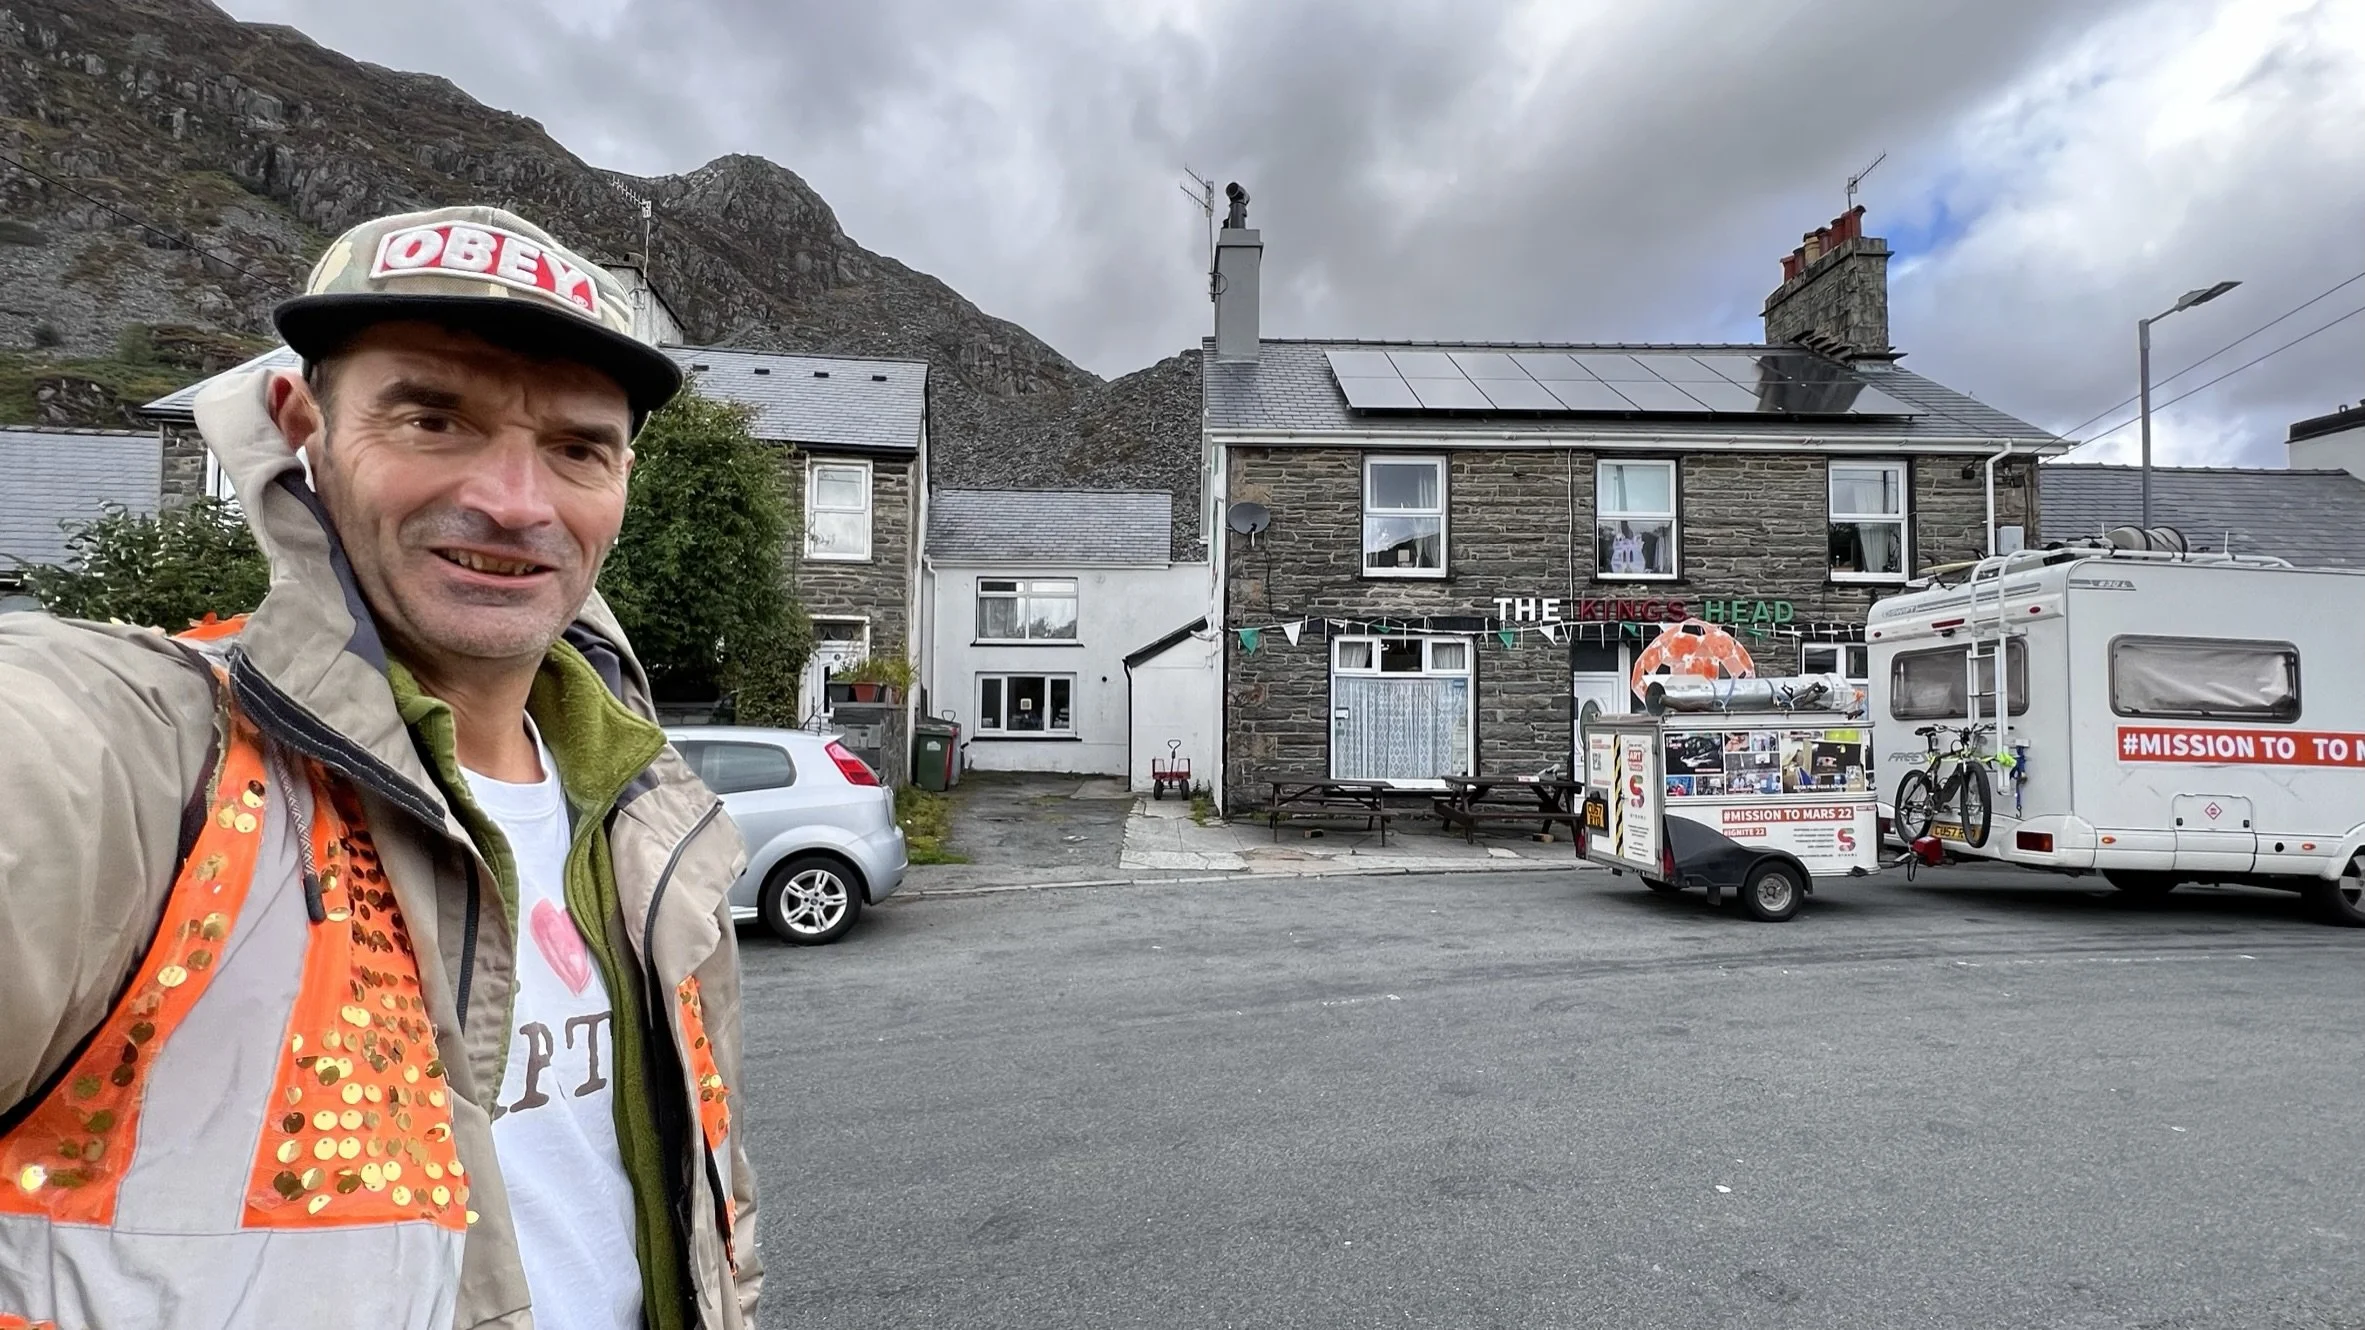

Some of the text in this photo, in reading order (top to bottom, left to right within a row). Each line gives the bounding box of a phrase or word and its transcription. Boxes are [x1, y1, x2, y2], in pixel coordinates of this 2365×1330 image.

[385, 226, 588, 302] OBEY
[1493, 598, 1794, 623] THE KINGS HEAD
[2123, 733, 2254, 758] #MISSION
[2259, 736, 2296, 760] TO
[2312, 738, 2349, 761] TO
[1723, 809, 1782, 822] #MISSION
[1784, 809, 1800, 821] TO
[1803, 808, 1836, 820] MARS
[1838, 808, 1853, 819] 22
[1723, 828, 1765, 837] #IGNITE 22
[1935, 826, 1957, 837] CU57
[493, 1010, 612, 1120] PT
